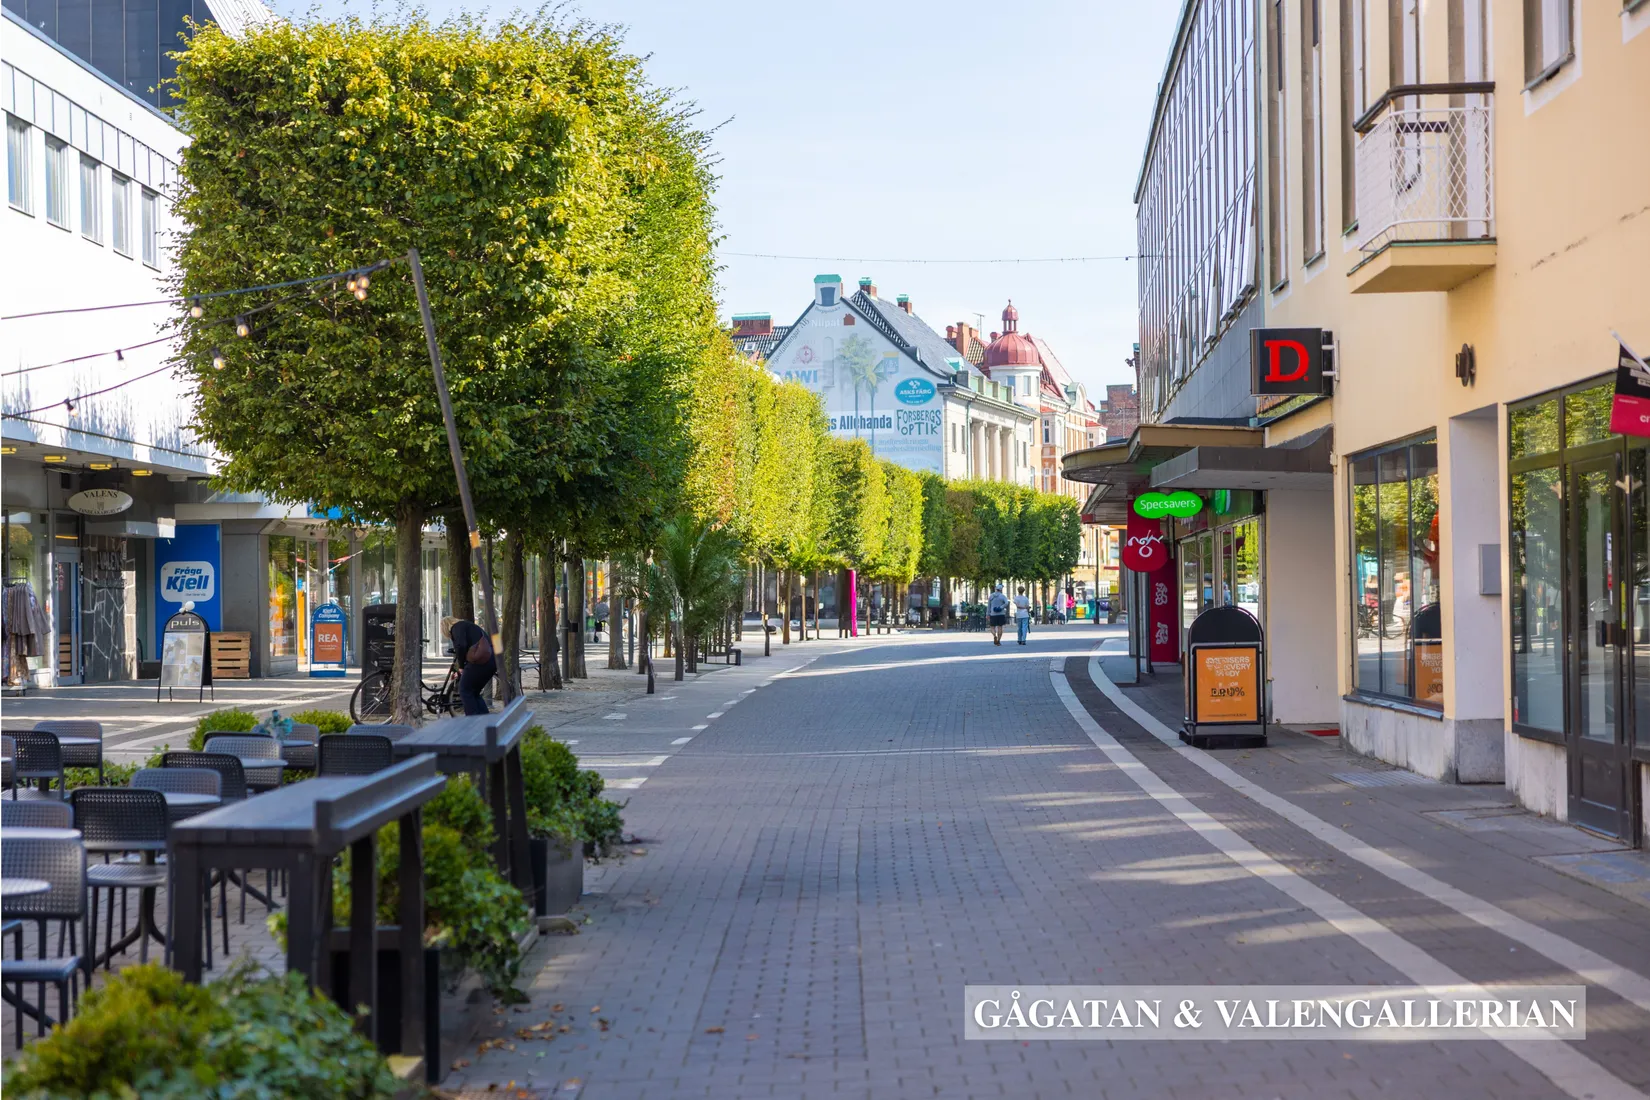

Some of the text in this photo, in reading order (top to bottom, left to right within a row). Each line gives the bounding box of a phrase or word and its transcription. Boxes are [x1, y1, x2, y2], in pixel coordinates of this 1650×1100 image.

[896, 409, 942, 431] FORSBERGS
[901, 422, 939, 435] OPTIK
[84, 490, 118, 498] VALENS
[1140, 499, 1196, 511] Specsavers
[174, 566, 203, 576] Fråga
[166, 575, 209, 592] Kjell
[171, 617, 200, 628] puls
[318, 634, 338, 642] REA
